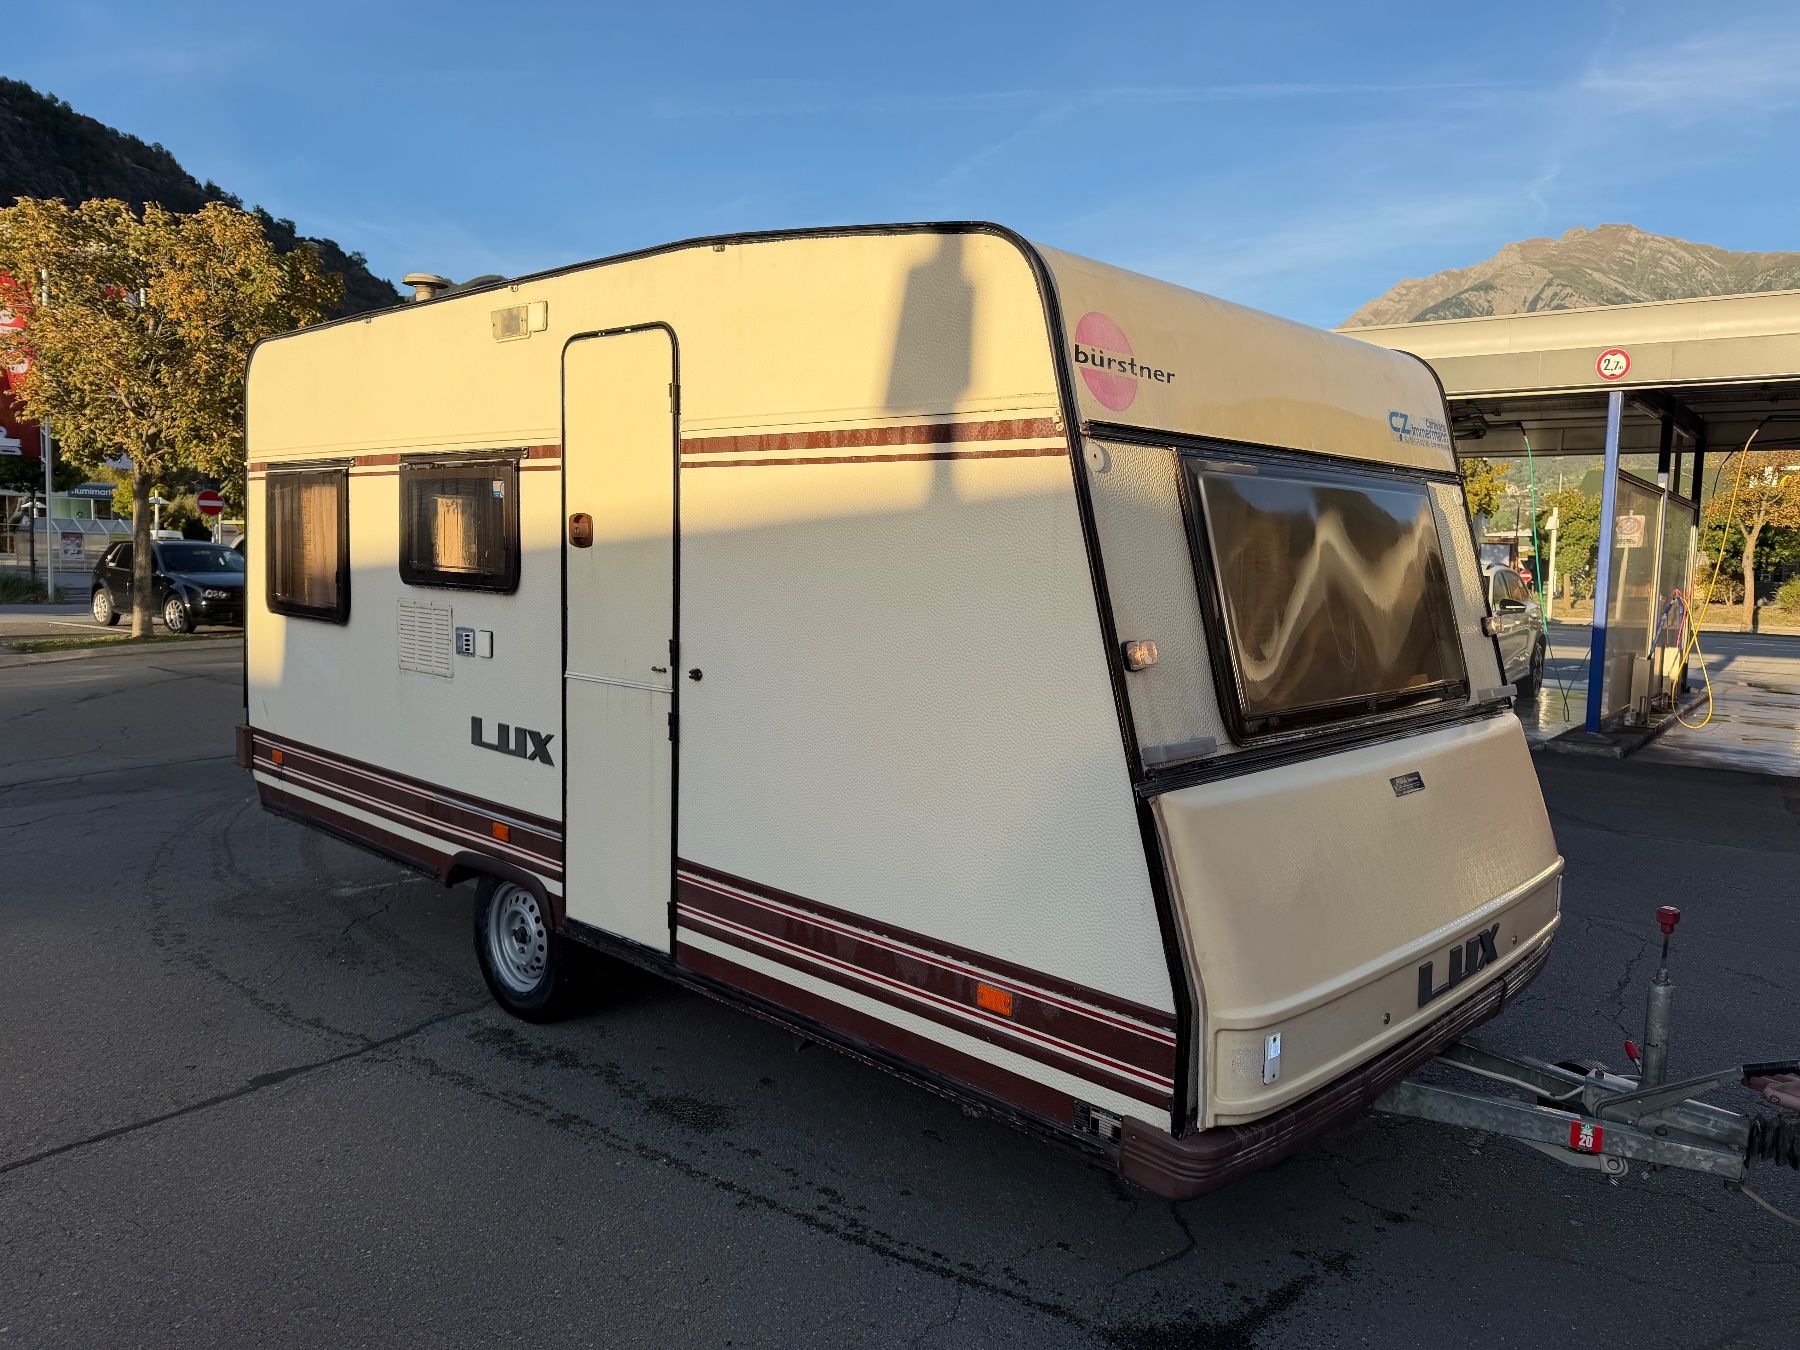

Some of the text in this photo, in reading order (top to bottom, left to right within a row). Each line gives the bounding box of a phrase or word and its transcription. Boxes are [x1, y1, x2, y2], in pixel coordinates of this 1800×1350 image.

[1074, 343, 1176, 384] bürstner
[470, 715, 555, 767] LUX
[1418, 922, 1500, 1009] LUX
[1578, 1134, 1594, 1148] 20
